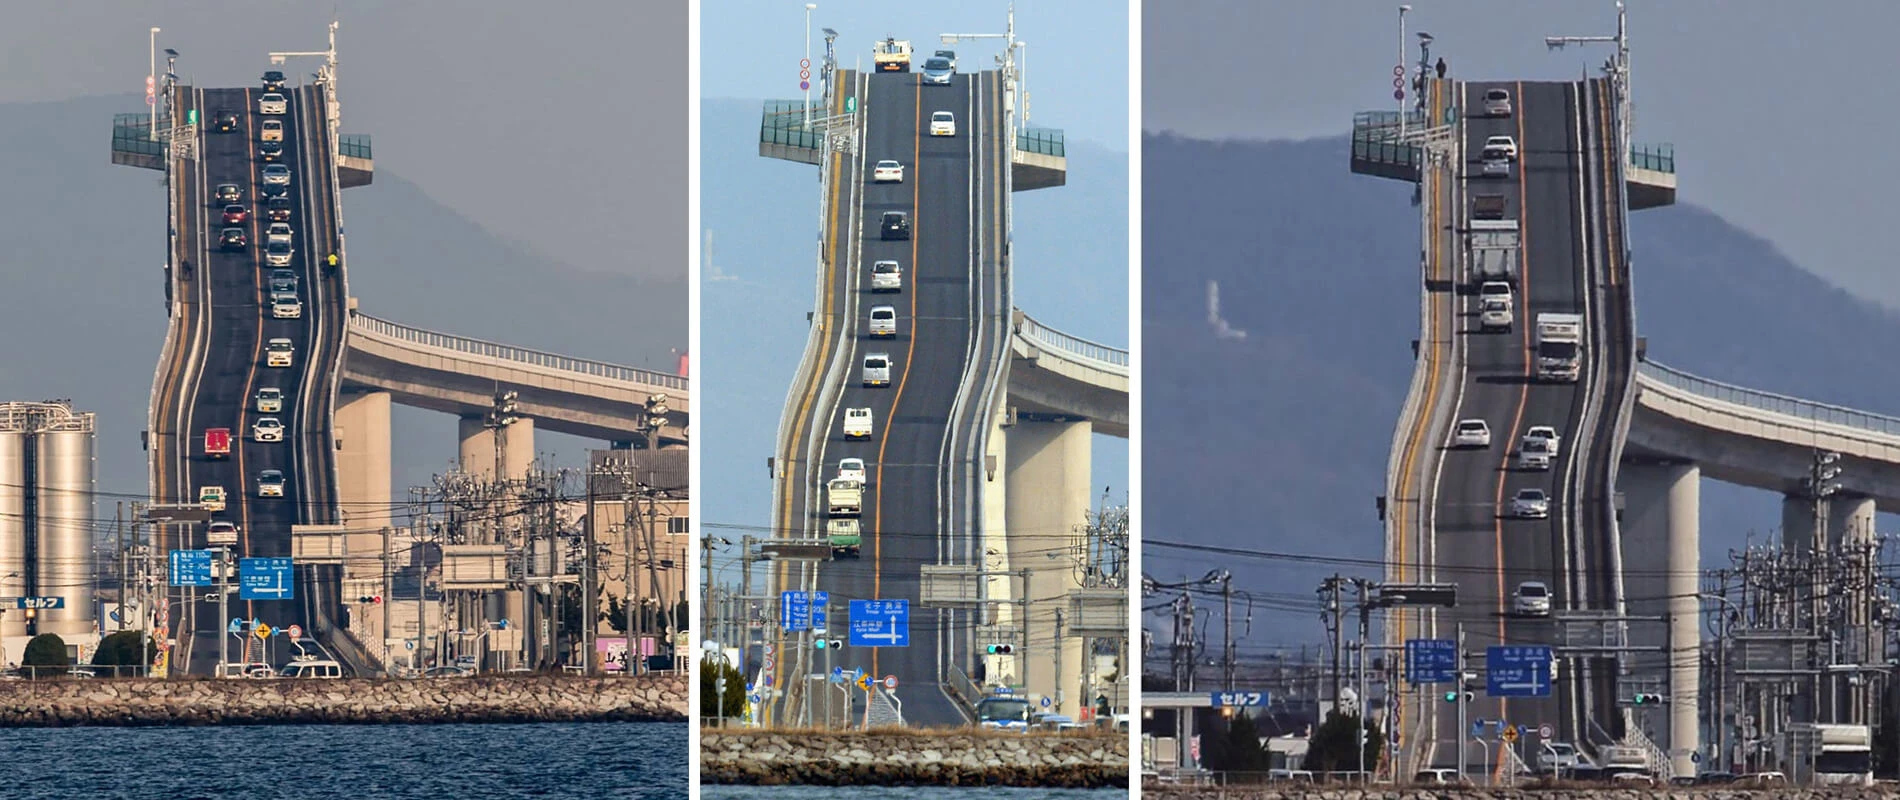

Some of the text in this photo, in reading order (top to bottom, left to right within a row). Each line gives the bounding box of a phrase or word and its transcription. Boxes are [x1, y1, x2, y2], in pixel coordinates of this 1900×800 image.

[24, 598, 58, 608] セルフ
[1220, 692, 1261, 705] セルフ
